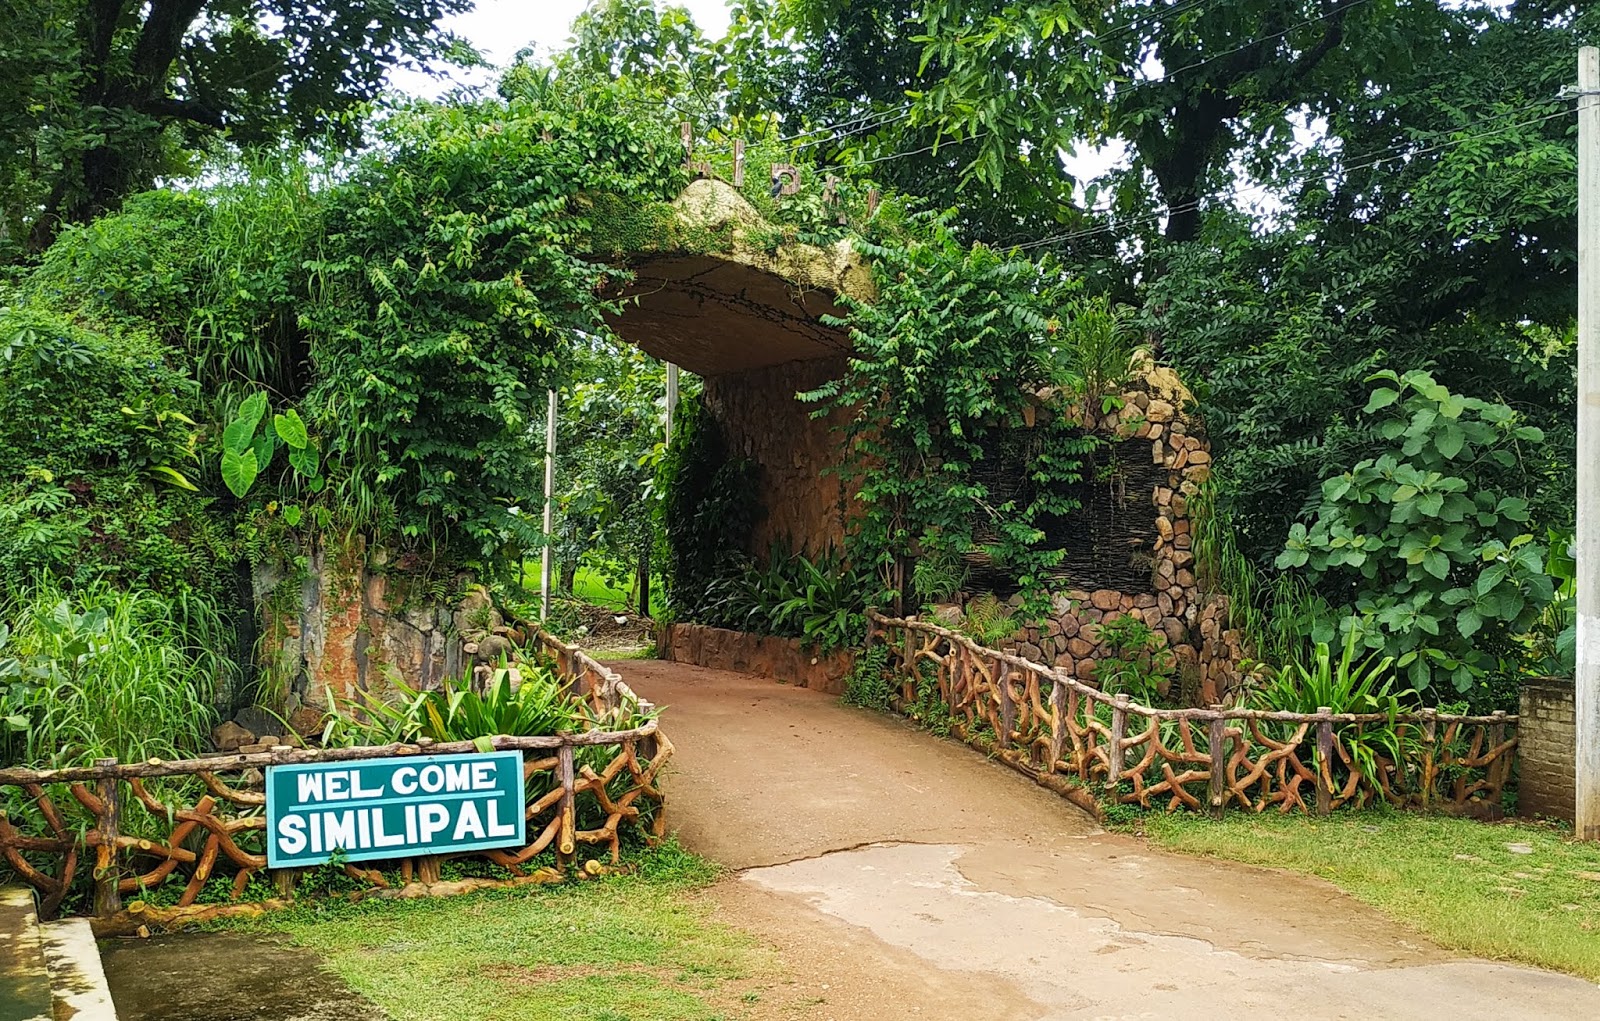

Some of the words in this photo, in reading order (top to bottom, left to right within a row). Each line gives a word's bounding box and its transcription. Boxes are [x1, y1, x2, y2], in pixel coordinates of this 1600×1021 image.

[297, 769, 384, 803] WEL
[391, 761, 497, 794] COME
[278, 799, 515, 854] SIMILIPAL
